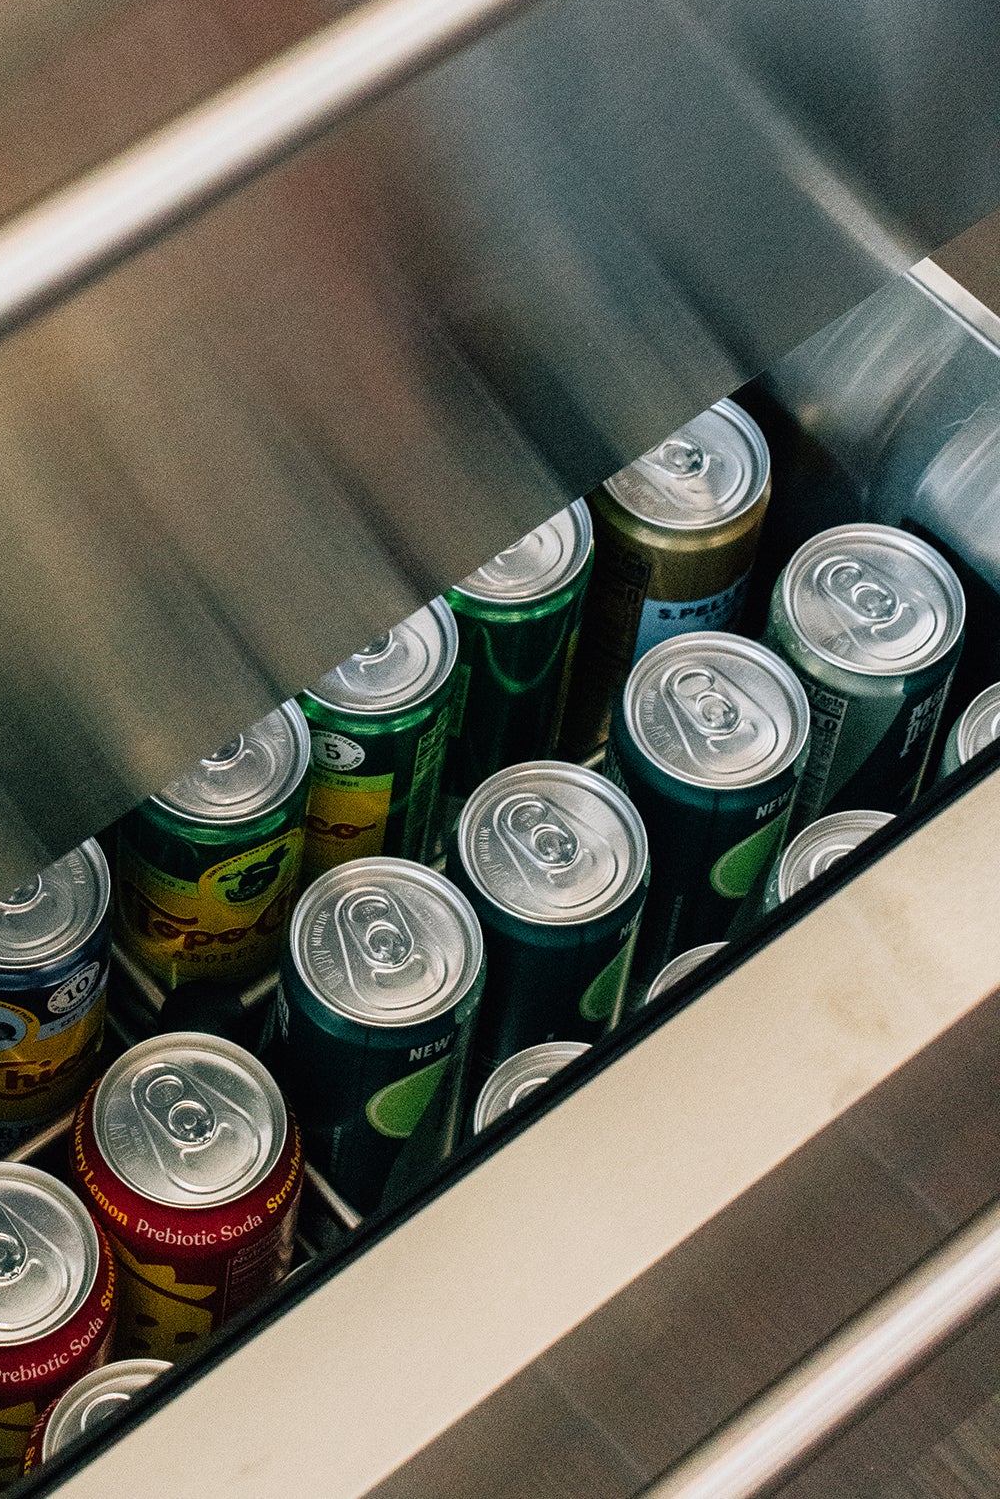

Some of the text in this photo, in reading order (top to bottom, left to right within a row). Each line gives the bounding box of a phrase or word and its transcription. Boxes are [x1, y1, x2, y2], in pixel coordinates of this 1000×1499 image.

[324, 743, 341, 760] 5
[64, 975, 91, 1004] 10
[83, 1171, 129, 1227] Lemon
[136, 1217, 217, 1247] Prebiotic
[220, 1214, 263, 1241] Soda
[69, 1317, 104, 1356] Soda
